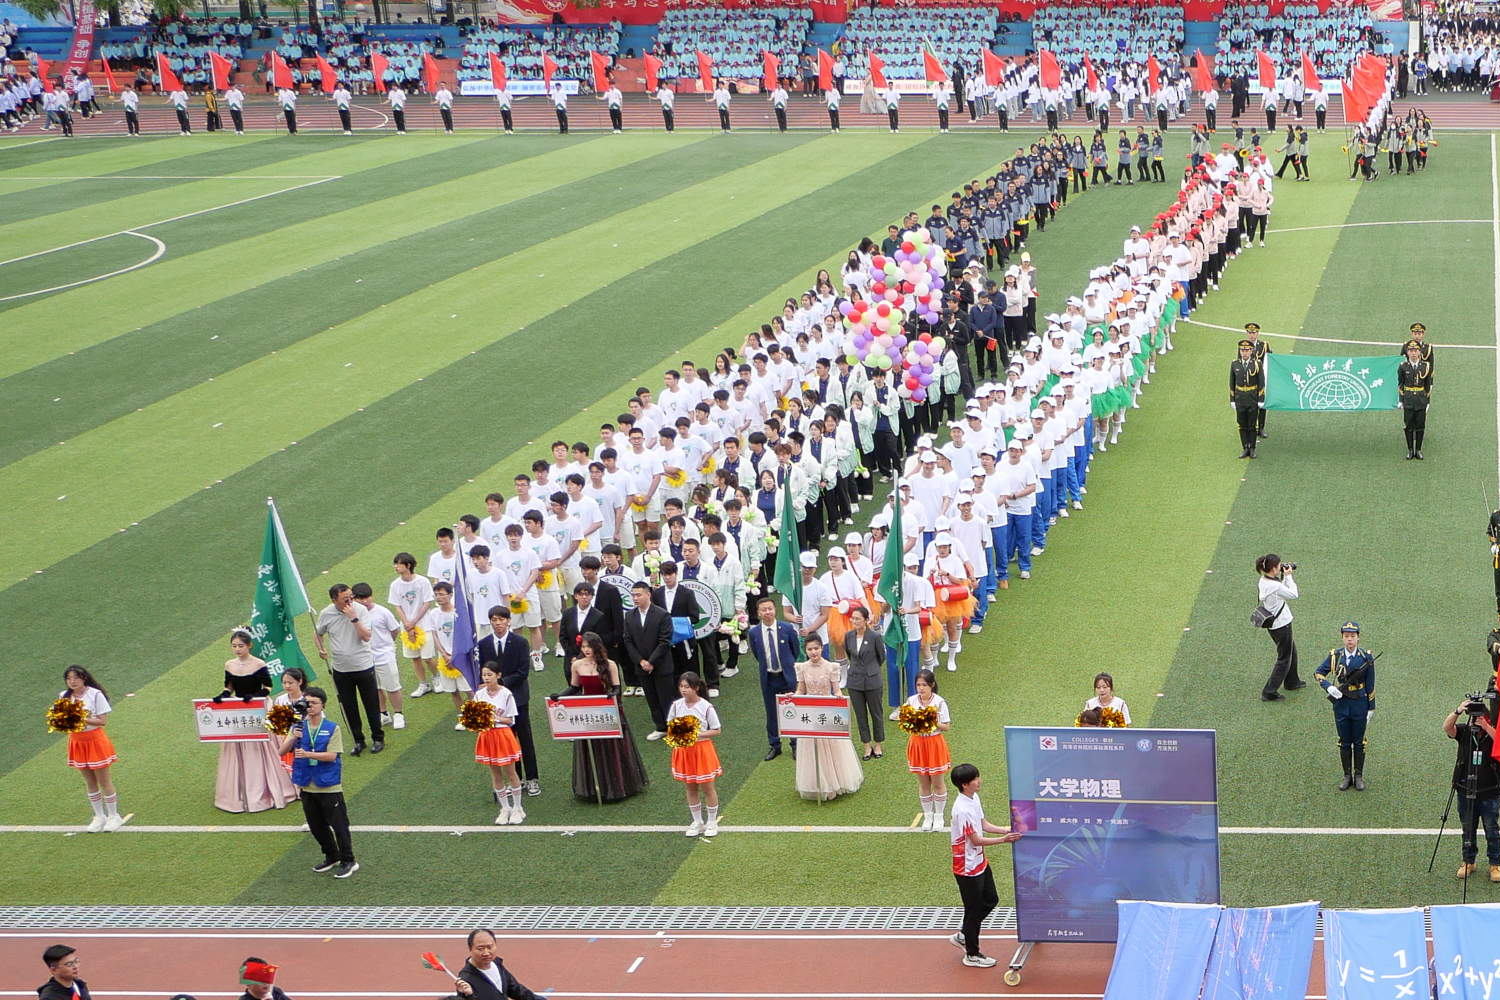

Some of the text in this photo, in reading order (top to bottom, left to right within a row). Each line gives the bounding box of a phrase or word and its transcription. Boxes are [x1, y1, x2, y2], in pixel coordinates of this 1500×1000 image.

[217, 716, 264, 728] 生命科学学院
[801, 713, 844, 726] 林学院
[1038, 778, 1122, 798] 大学物理
